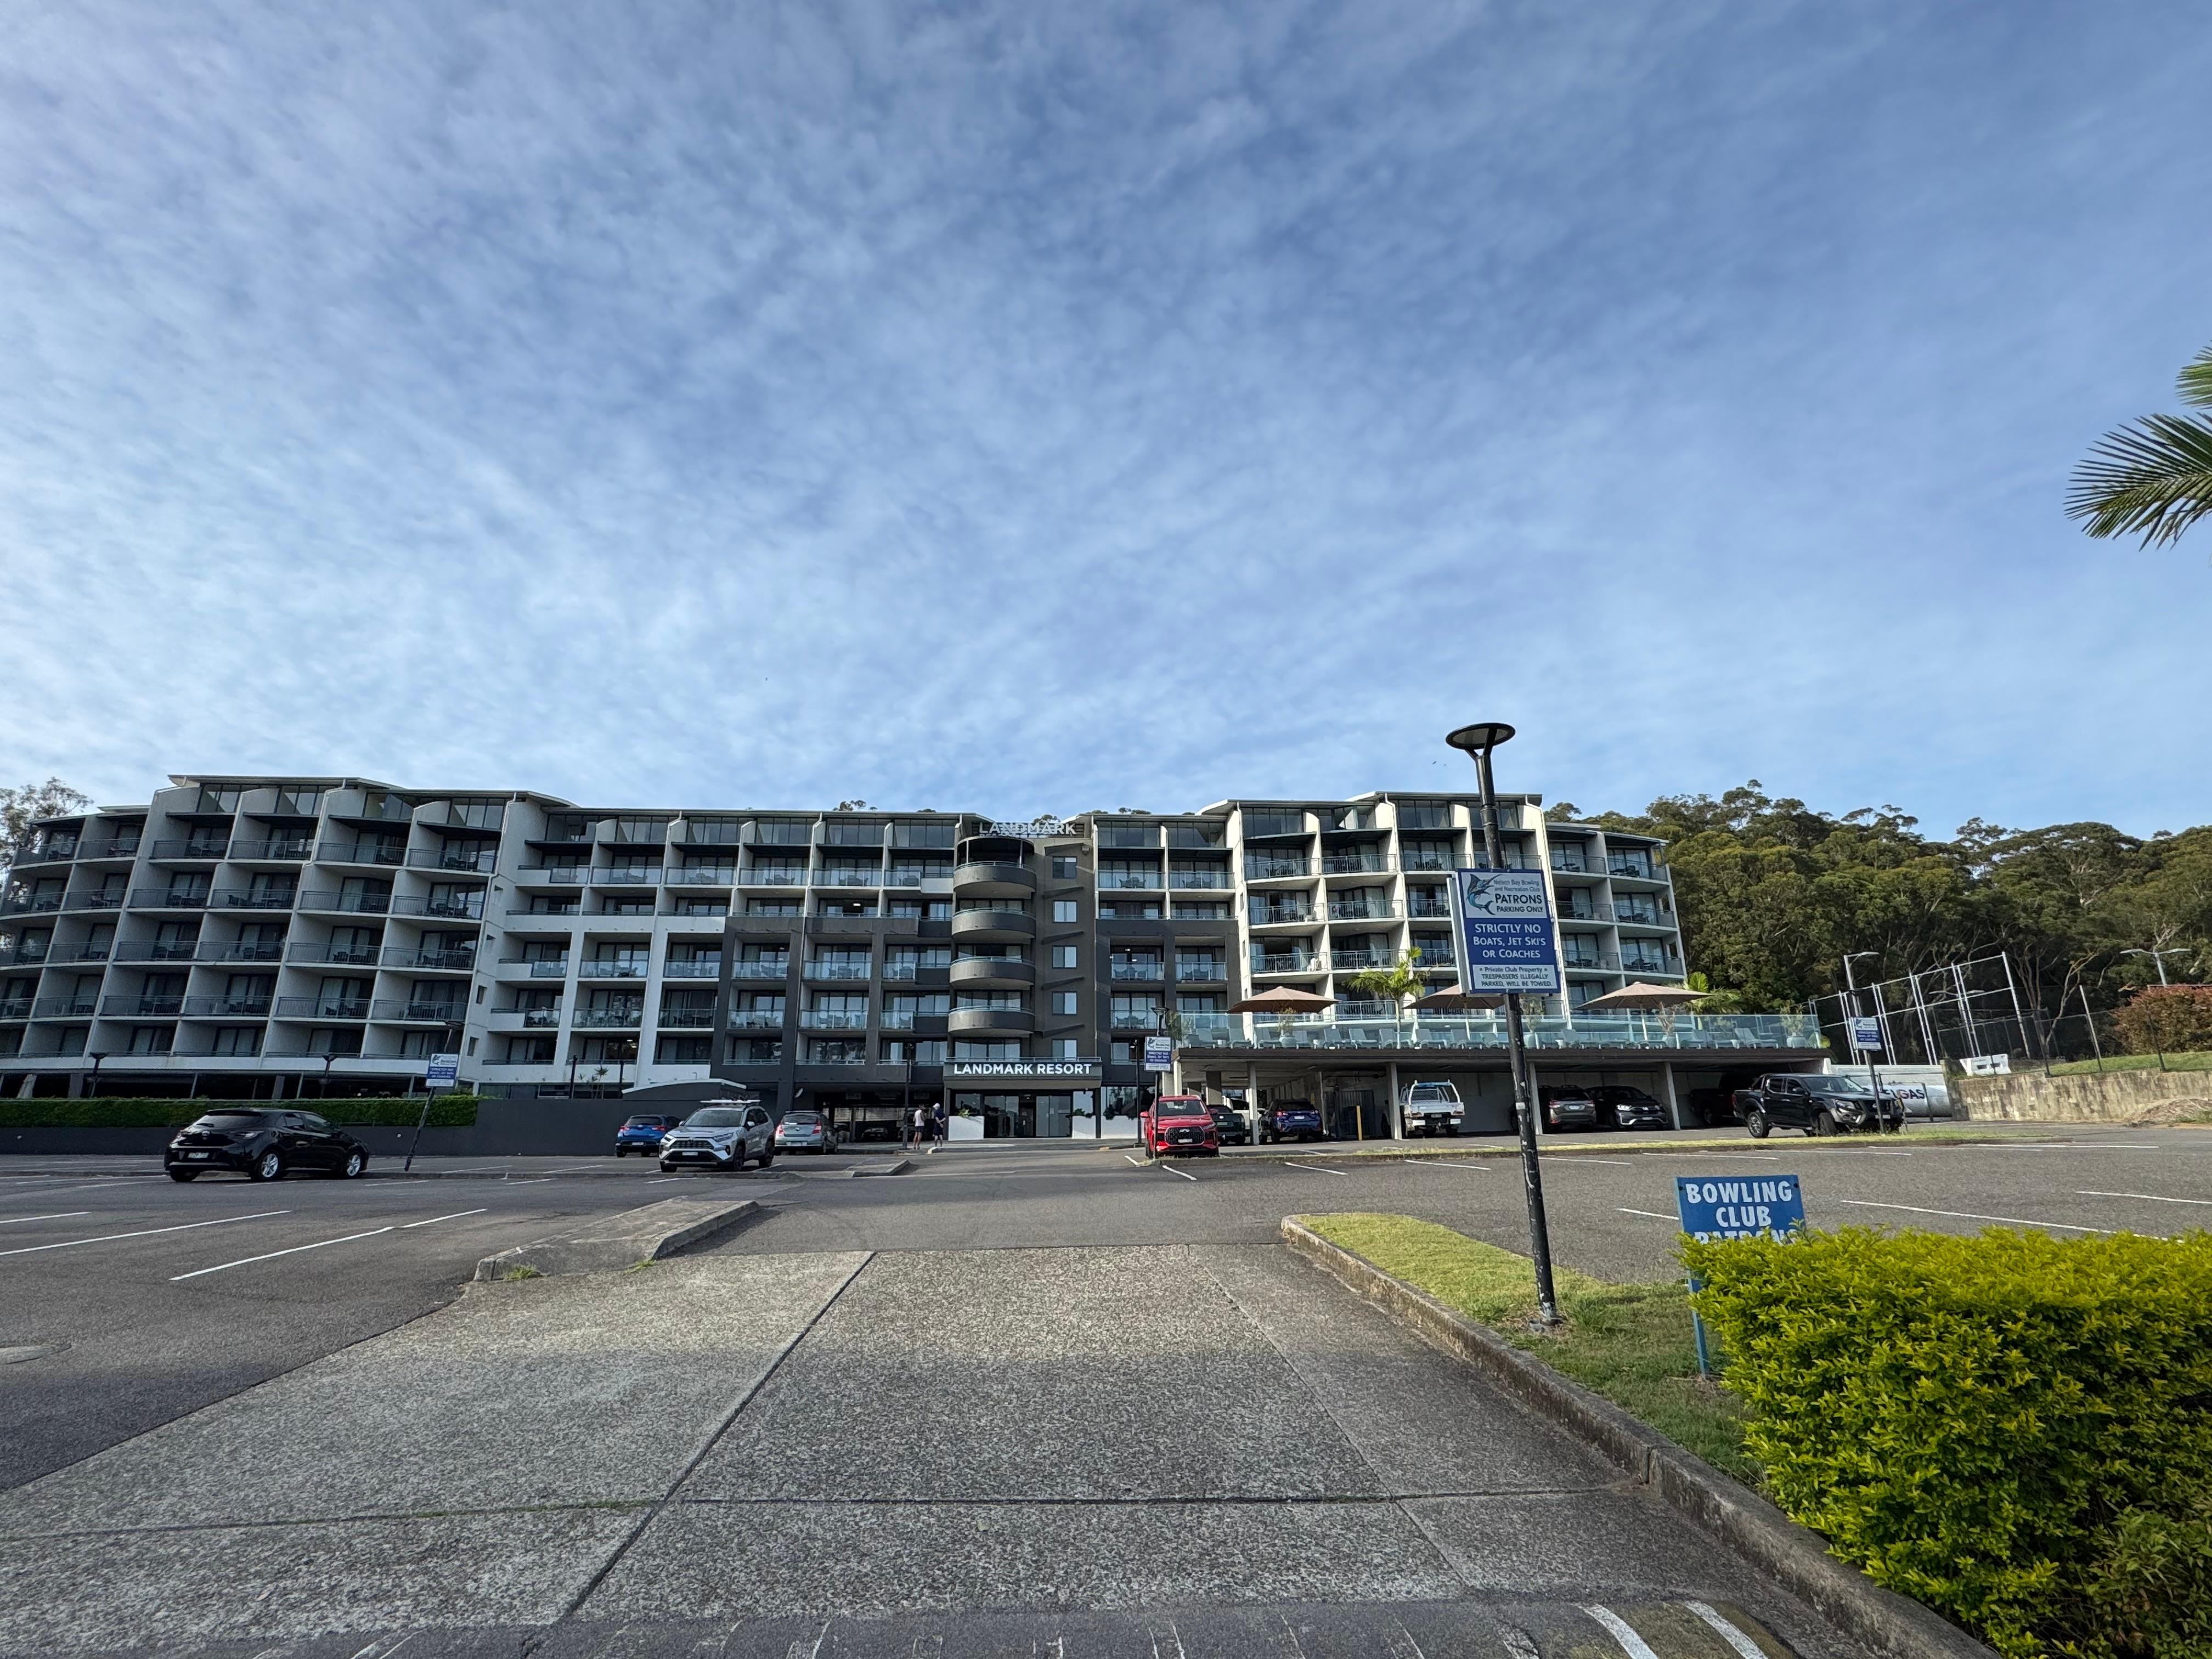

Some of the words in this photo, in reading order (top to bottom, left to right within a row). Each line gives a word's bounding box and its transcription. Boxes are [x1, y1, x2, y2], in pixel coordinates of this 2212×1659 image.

[979, 822, 1076, 834] LANDMARK
[1495, 893, 1542, 904] PATRONS
[1475, 923, 1521, 933] STRICTLY
[1524, 924, 1541, 933] NO
[1472, 936, 1505, 946] BOATS,
[1508, 936, 1522, 945] JET
[1482, 950, 1496, 958] OR
[1499, 949, 1541, 958] COACHES
[954, 1063, 1033, 1074] LANDMARK
[1037, 1063, 1092, 1074] RESORT
[1685, 1181, 1792, 1204] BOWLING
[1716, 1206, 1772, 1228] CLUB
